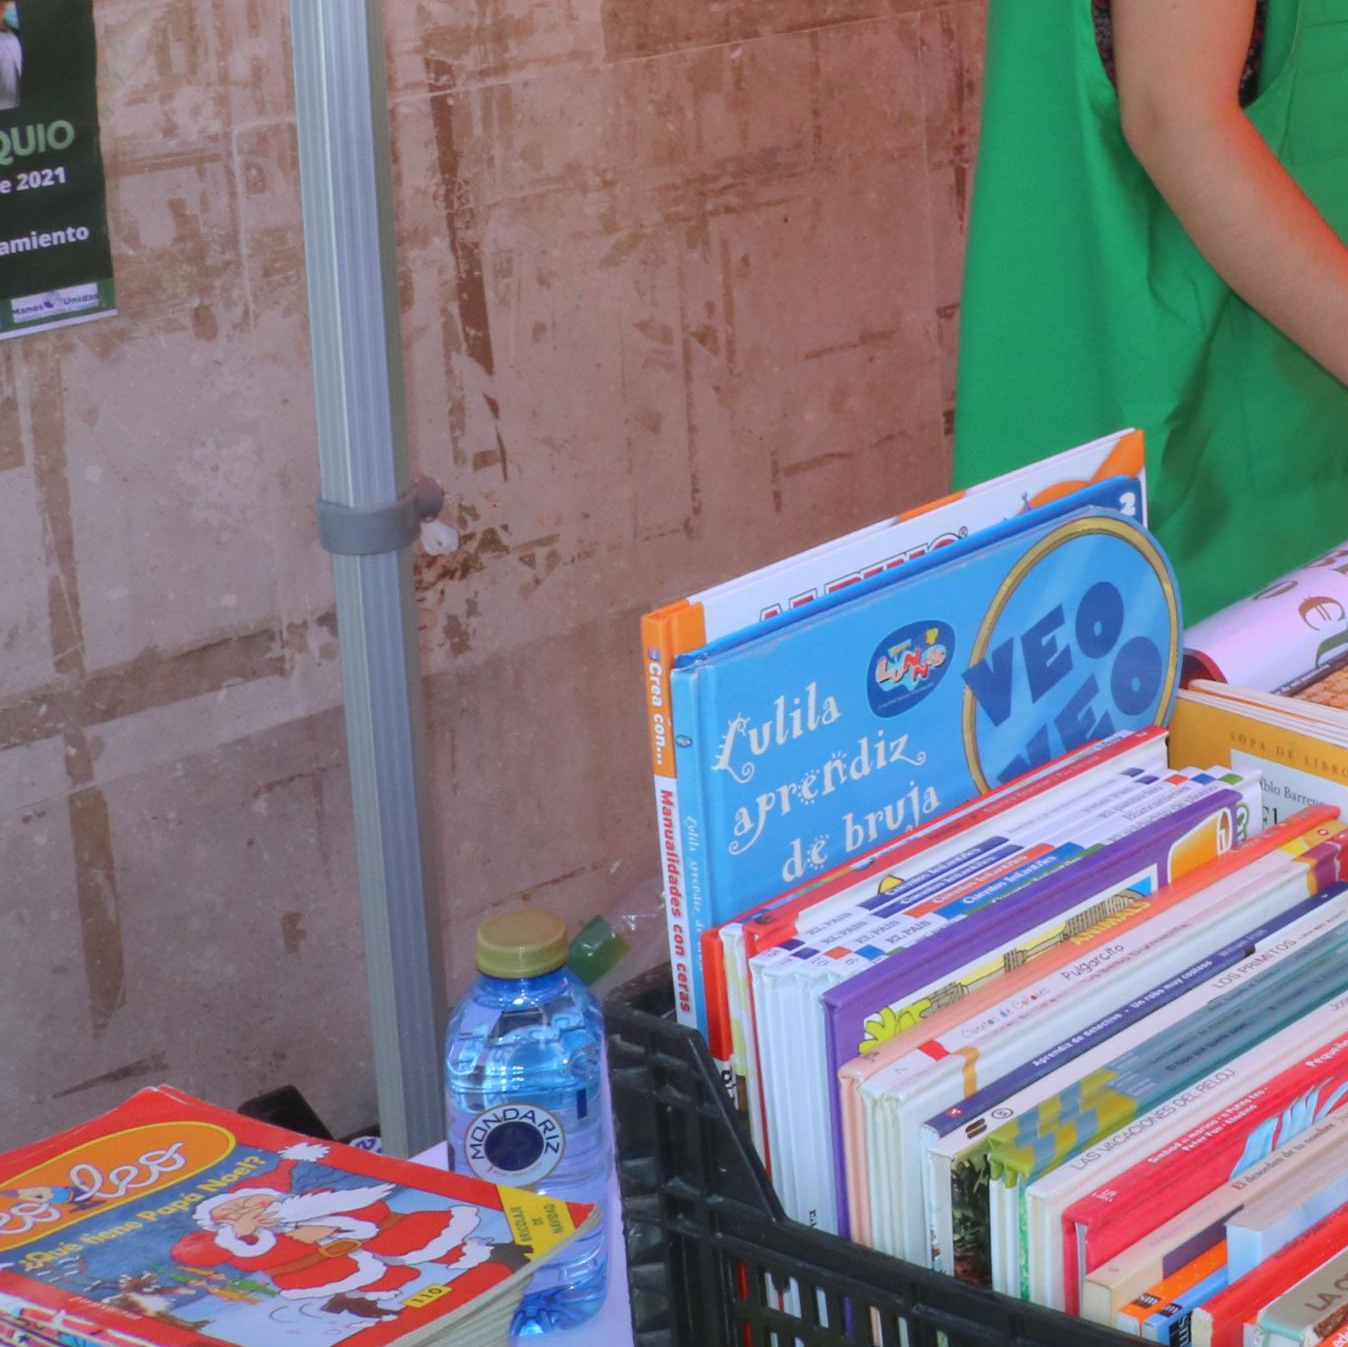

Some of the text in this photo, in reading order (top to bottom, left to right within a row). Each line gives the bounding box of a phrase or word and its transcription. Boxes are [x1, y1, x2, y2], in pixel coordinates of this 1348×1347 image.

[17, 166, 66, 191] 2021
[1118, 492, 1137, 516] 2
[960, 580, 1126, 728] VEO
[648, 662, 665, 766] Crea con...
[711, 680, 841, 784] Lulila
[1229, 730, 1267, 751] SOPA
[1276, 745, 1295, 760] DE
[728, 730, 928, 855] aprendiz
[781, 832, 830, 883] de
[844, 780, 942, 853] bruja
[659, 789, 692, 1014] Manualidades con ceras
[1070, 894, 1151, 948] ANIMALS
[1061, 940, 1126, 985] Pulgarcito
[1212, 934, 1298, 991] LOS PRIMITOS
[470, 1106, 561, 1162] MONDARIZ
[19, 1156, 267, 1270] ¿Qué tiene Papá Noel?
[510, 1206, 532, 1242] BRICOLAJE
[532, 1217, 543, 1226] DE
[543, 1204, 563, 1234] NAVIDAD
[409, 1285, 445, 1307] 110
[1305, 1285, 1339, 1317] LA
